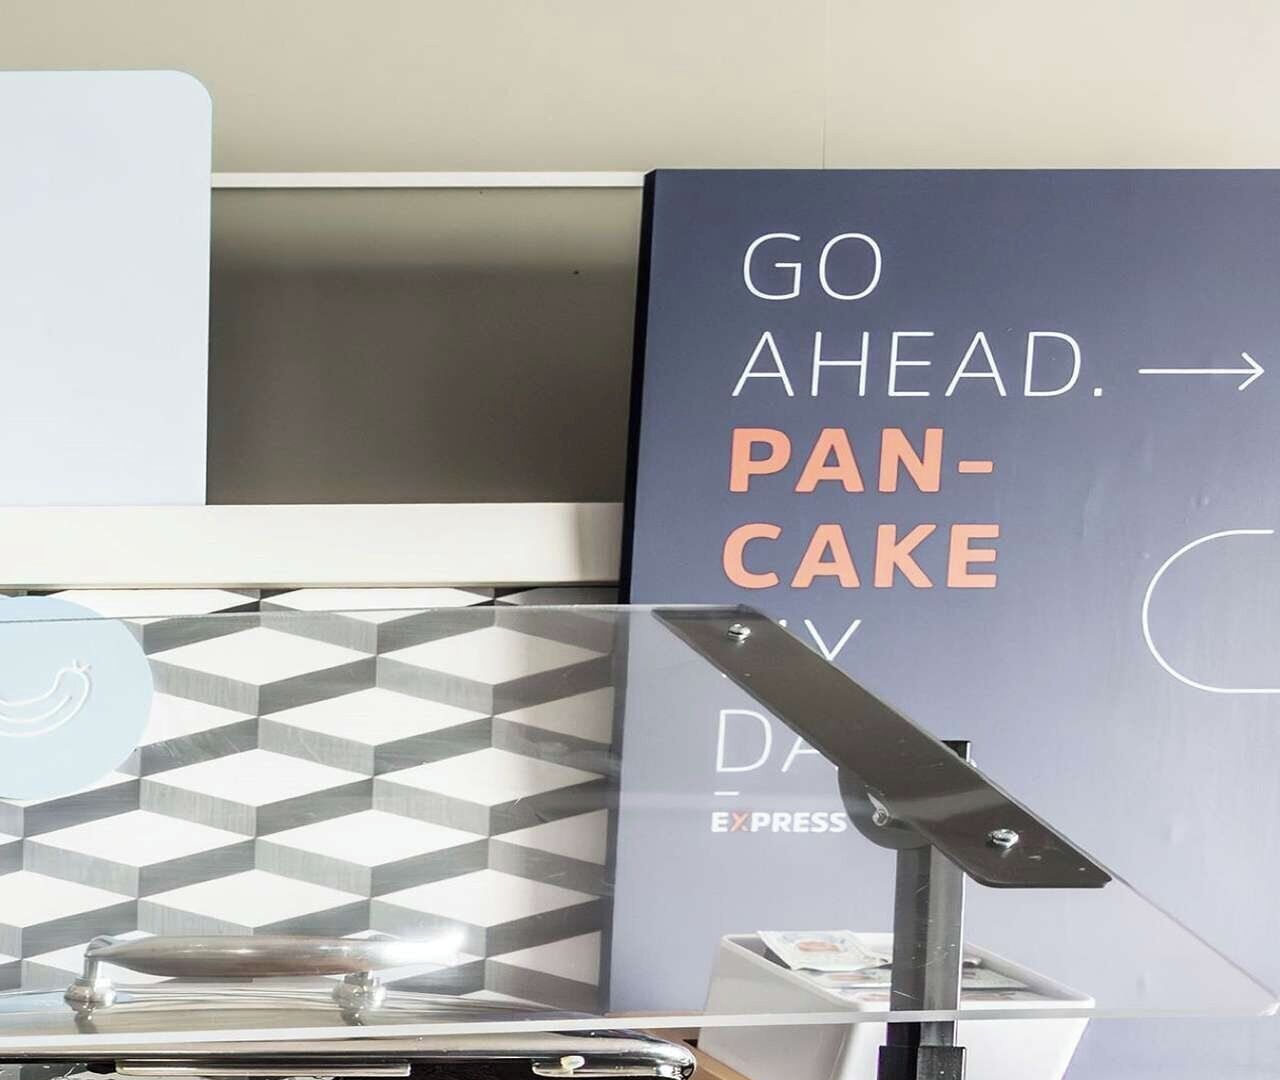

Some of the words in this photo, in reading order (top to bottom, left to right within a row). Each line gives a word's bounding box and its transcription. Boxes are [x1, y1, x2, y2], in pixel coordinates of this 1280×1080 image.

[742, 232, 883, 301] GO
[732, 331, 1104, 397] AHEAD.
[728, 428, 995, 493] PAN-
[721, 523, 1001, 589] CAKE
[715, 708, 840, 773] DA
[710, 811, 848, 833] EXPRESS
